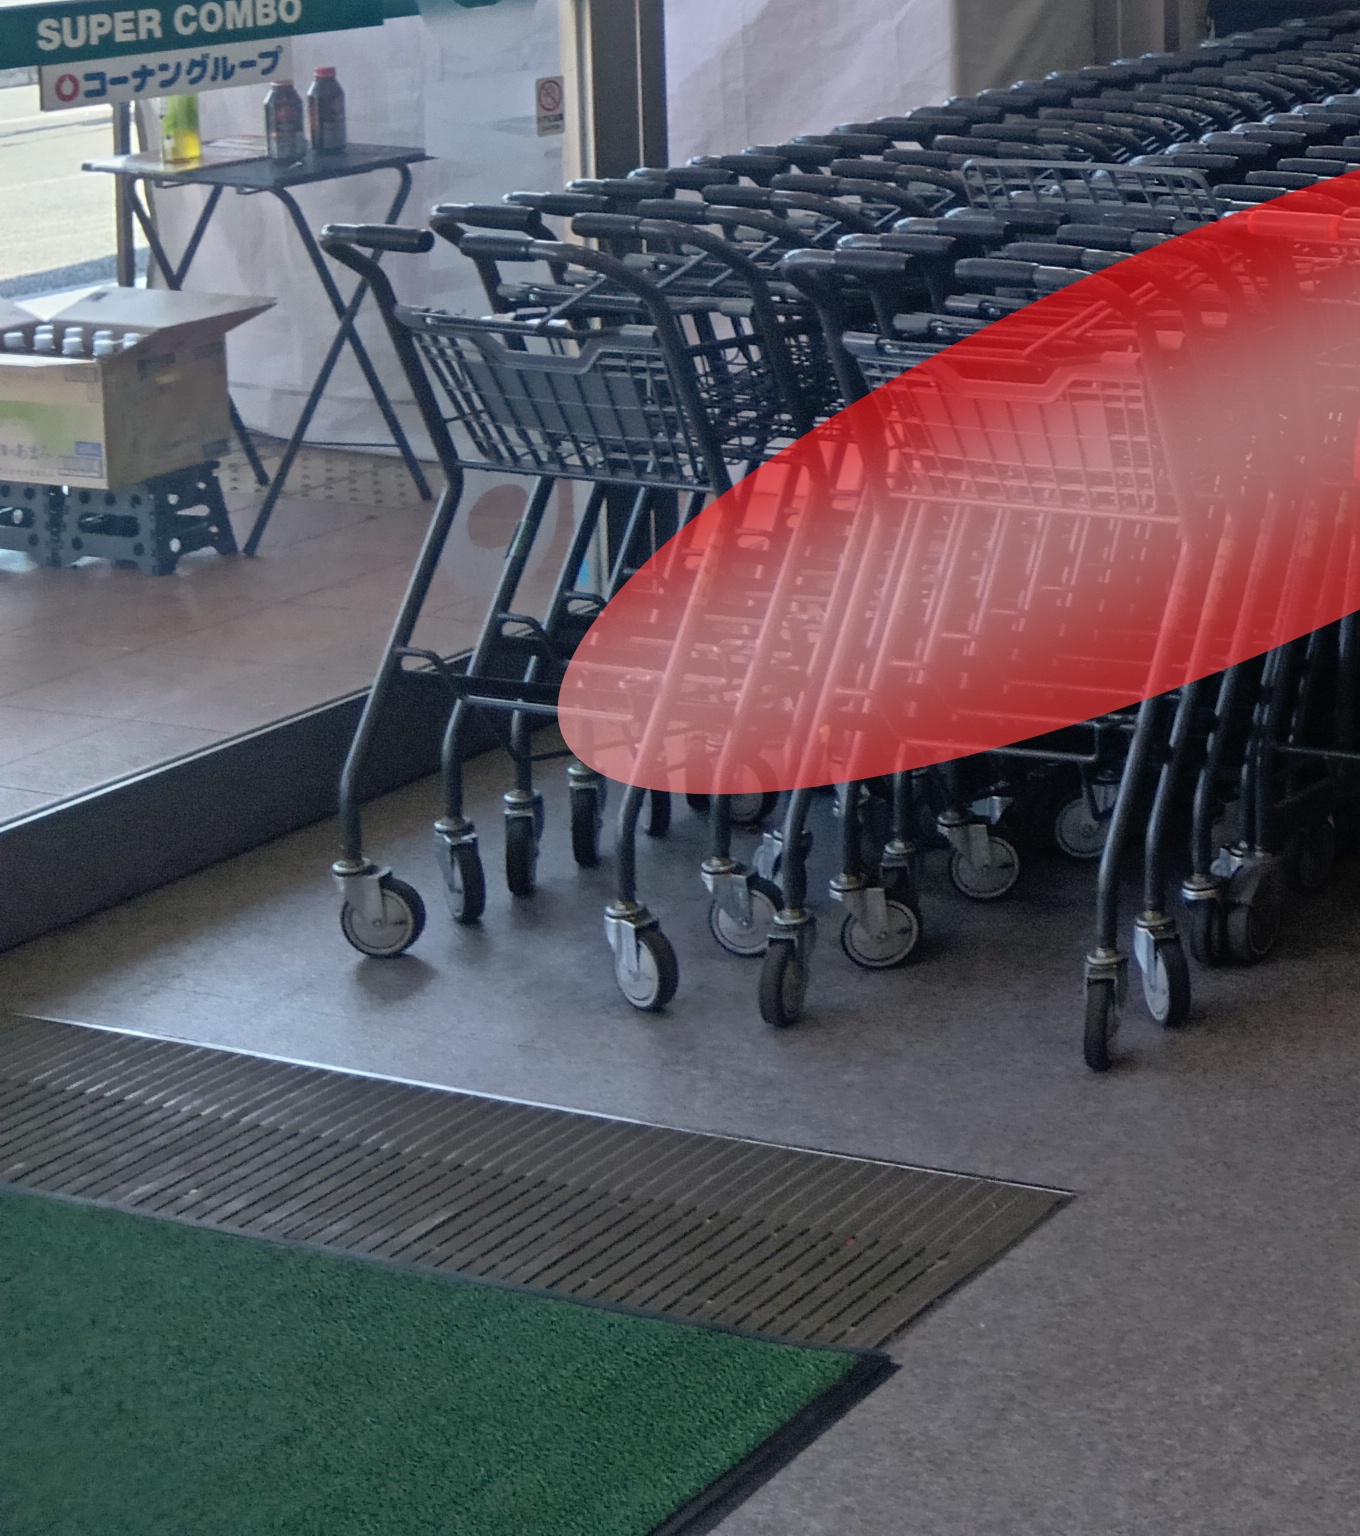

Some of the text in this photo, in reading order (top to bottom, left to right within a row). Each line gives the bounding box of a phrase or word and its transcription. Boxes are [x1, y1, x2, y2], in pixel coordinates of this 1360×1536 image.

[37, 8, 163, 51] SUPER
[83, 45, 284, 99] コーナングループ
